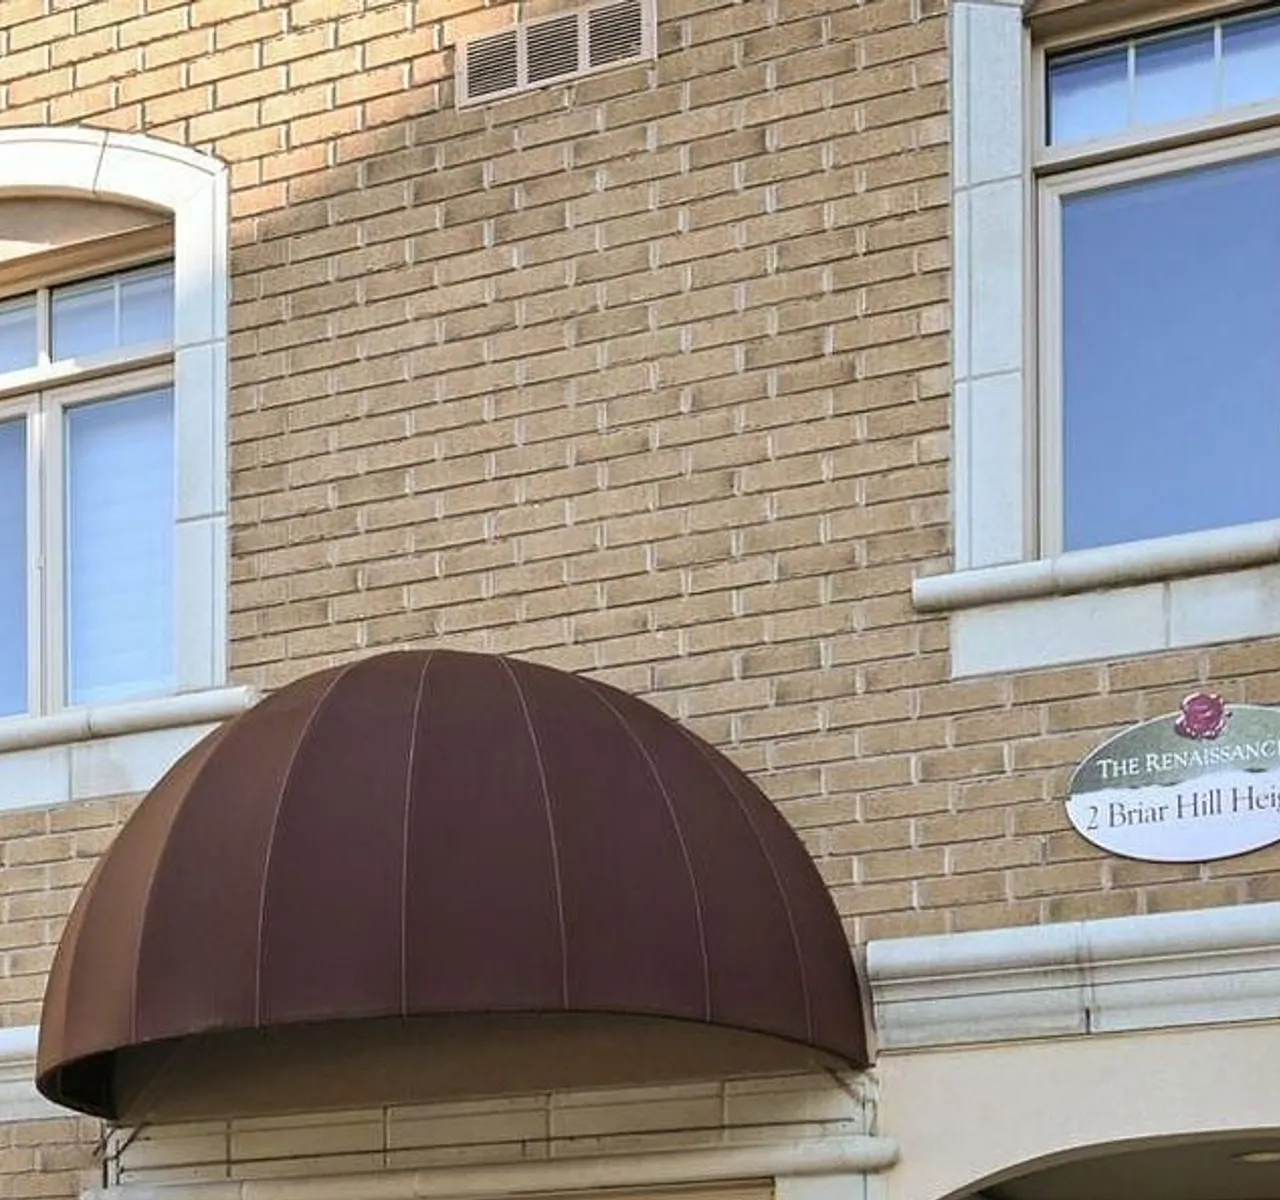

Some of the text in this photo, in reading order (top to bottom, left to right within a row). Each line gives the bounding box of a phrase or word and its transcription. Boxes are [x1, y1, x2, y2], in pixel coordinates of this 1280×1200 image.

[1097, 758, 1140, 778] THE
[1086, 806, 1099, 830] 2
[1108, 801, 1169, 828] Briar
[1177, 788, 1222, 819] Hill
